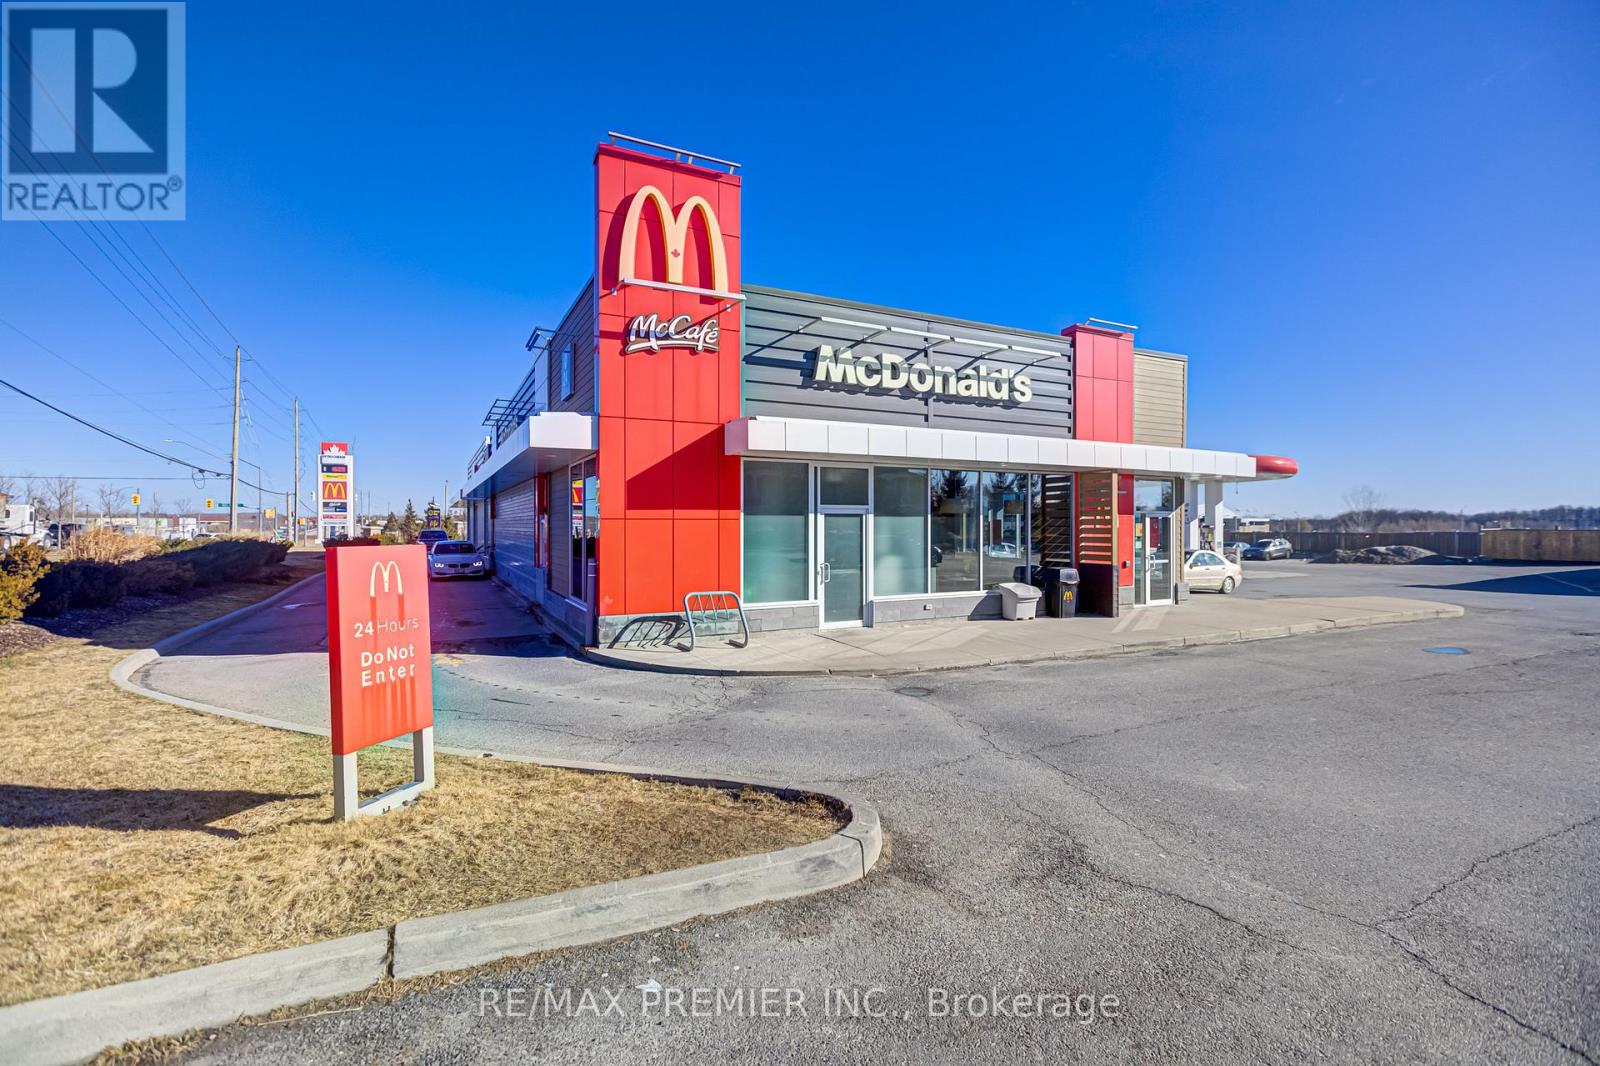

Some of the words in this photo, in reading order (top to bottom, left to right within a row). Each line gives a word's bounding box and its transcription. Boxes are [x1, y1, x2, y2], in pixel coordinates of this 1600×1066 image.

[629, 314, 719, 351] McCafé
[813, 344, 1032, 405] McDonald's
[354, 620, 374, 638] 24
[377, 617, 420, 634] Hours
[360, 651, 384, 667] Do
[386, 643, 415, 662] Not
[361, 663, 415, 687] Enter
